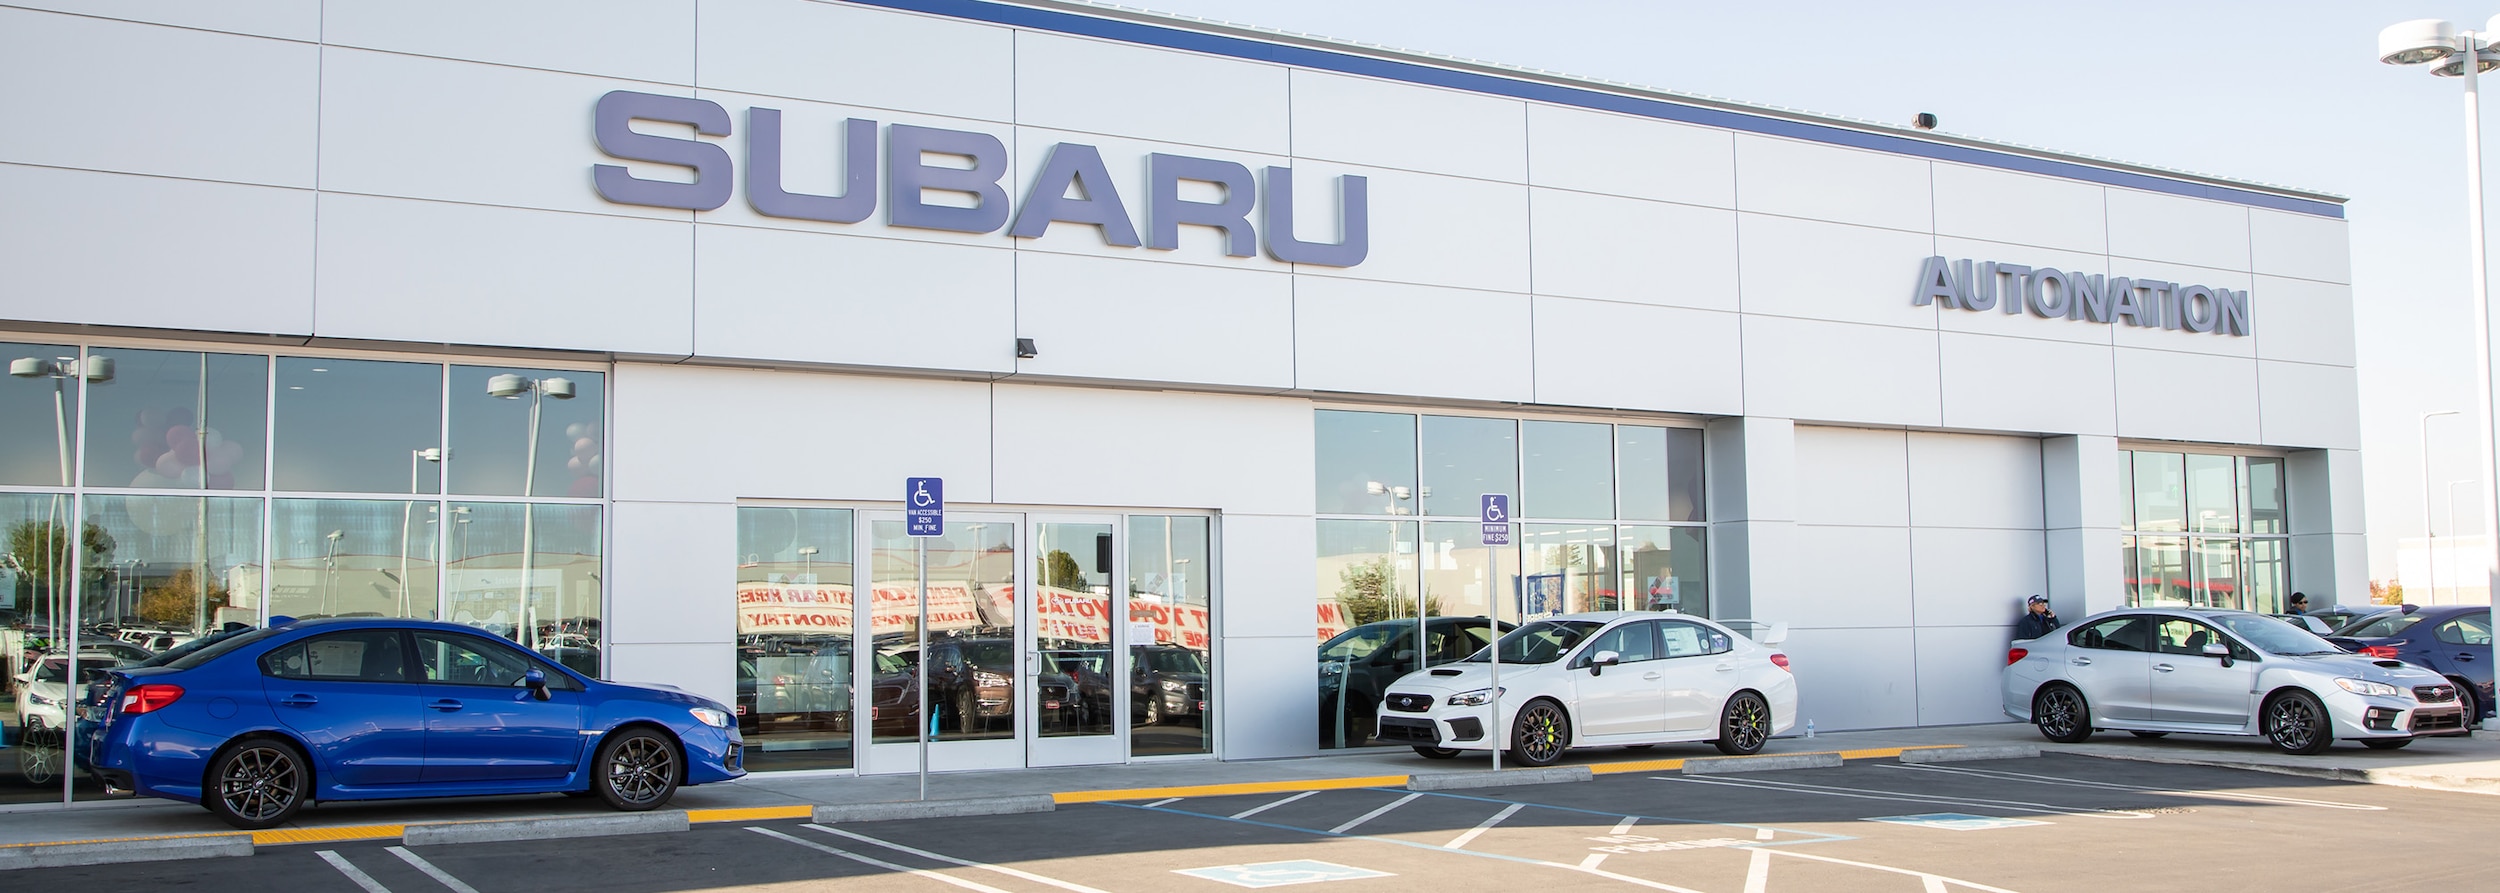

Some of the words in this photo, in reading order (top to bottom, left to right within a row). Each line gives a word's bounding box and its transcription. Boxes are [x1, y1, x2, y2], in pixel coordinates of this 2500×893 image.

[592, 89, 1368, 268] SUBARU
[1914, 255, 2250, 337] AUTONATION
[1483, 533, 1495, 541] FINE
[1495, 532, 1508, 542] $250
[1484, 525, 1507, 533] MINIMUM
